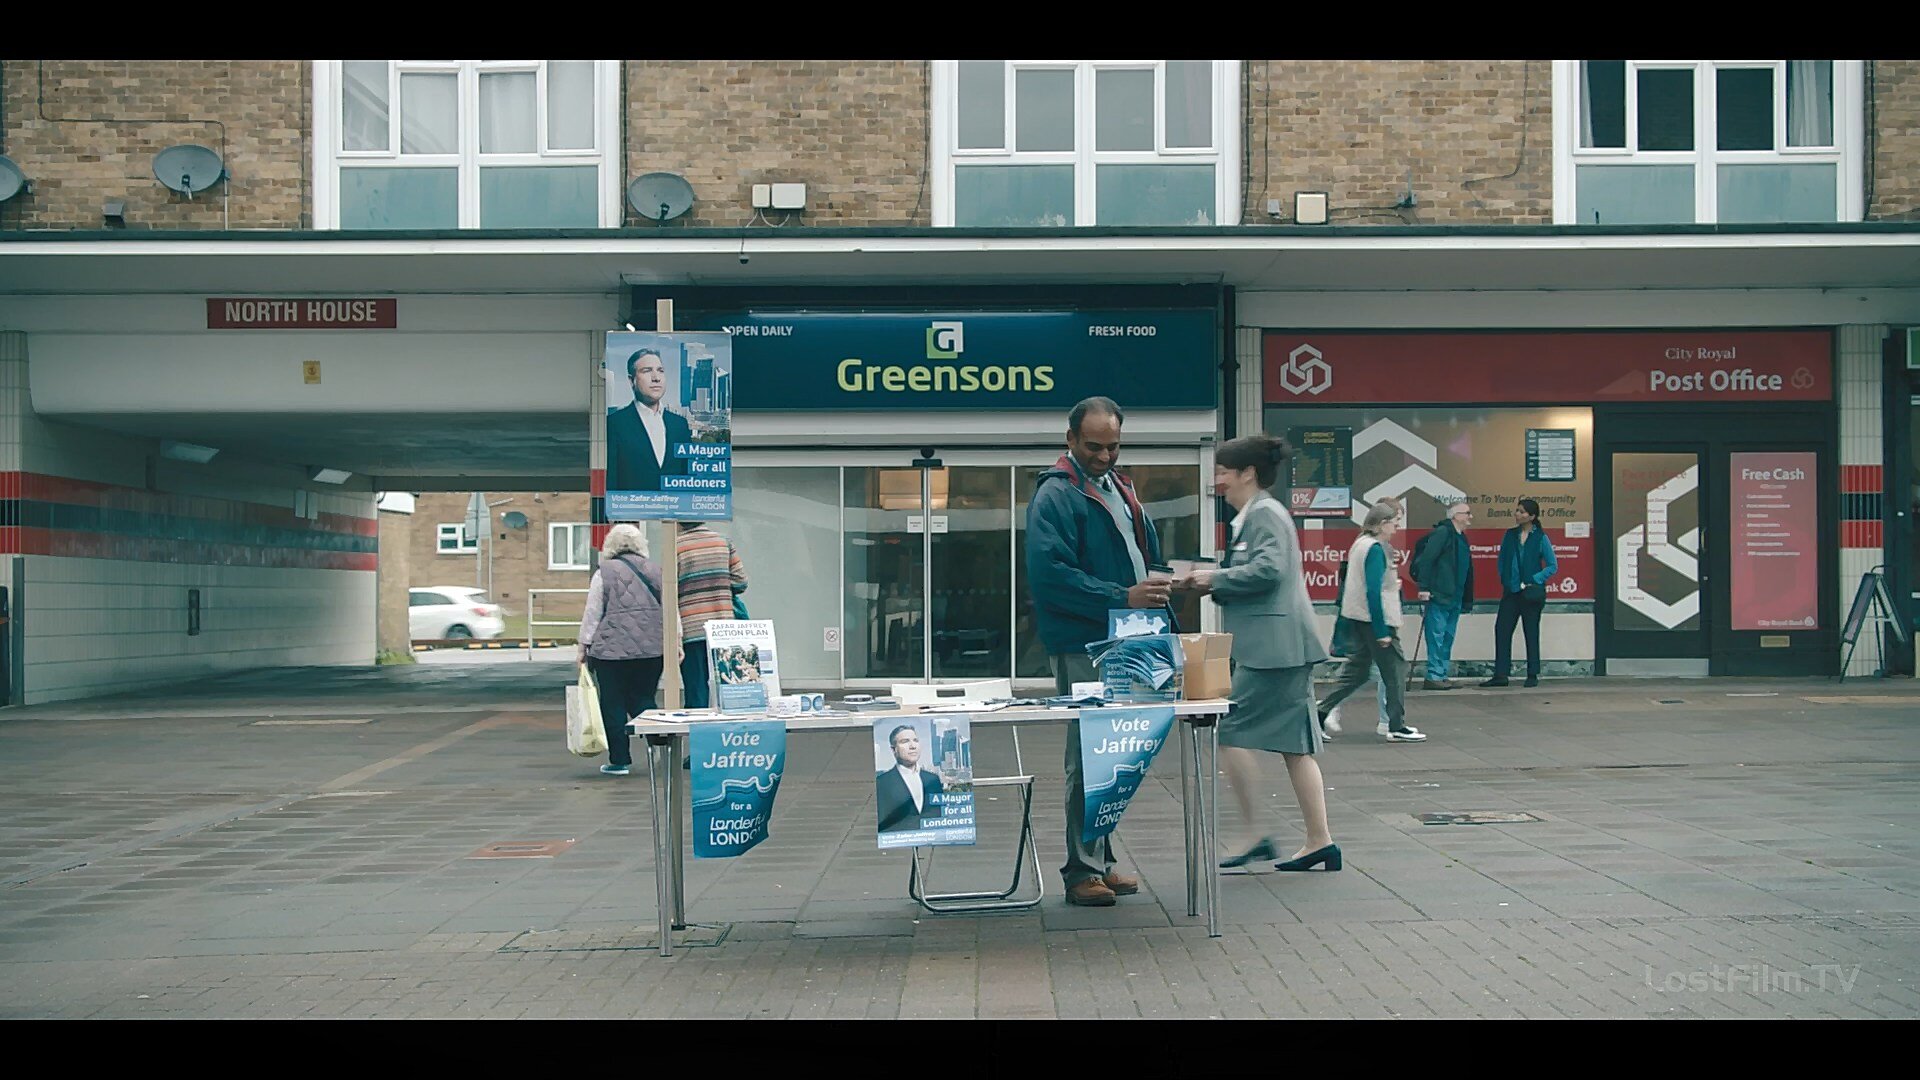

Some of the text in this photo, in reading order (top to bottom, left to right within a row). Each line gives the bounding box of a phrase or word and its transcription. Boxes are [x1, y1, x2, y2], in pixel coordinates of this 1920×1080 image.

[225, 301, 377, 322] NORTH HOUSE
[729, 325, 794, 336] OPEN DAILY
[1088, 326, 1157, 337] FRESH FOOD
[1664, 346, 1736, 362] City Royal
[836, 358, 1055, 392] Greensons
[1650, 368, 1783, 392] Post Office
[677, 444, 727, 459] A Mayor
[692, 461, 727, 472] for all
[1741, 467, 1805, 481] Free Cash
[664, 476, 727, 488] Londoners
[691, 502, 726, 510] LONDON
[1434, 494, 1577, 506] Welcome To Your Community
[1486, 507, 1513, 518] Bank
[1547, 507, 1577, 518] Office
[1303, 570, 1340, 587] Worl
[711, 629, 769, 637] ACTION PLAN
[1111, 717, 1151, 733] Vote
[721, 732, 761, 747] Vote
[1093, 736, 1162, 754] Jaffrey
[703, 751, 778, 771] Jaffrey
[932, 793, 972, 805] A Mayor
[730, 802, 744, 811] for
[944, 805, 973, 815] for all
[923, 816, 974, 828] Londoners
